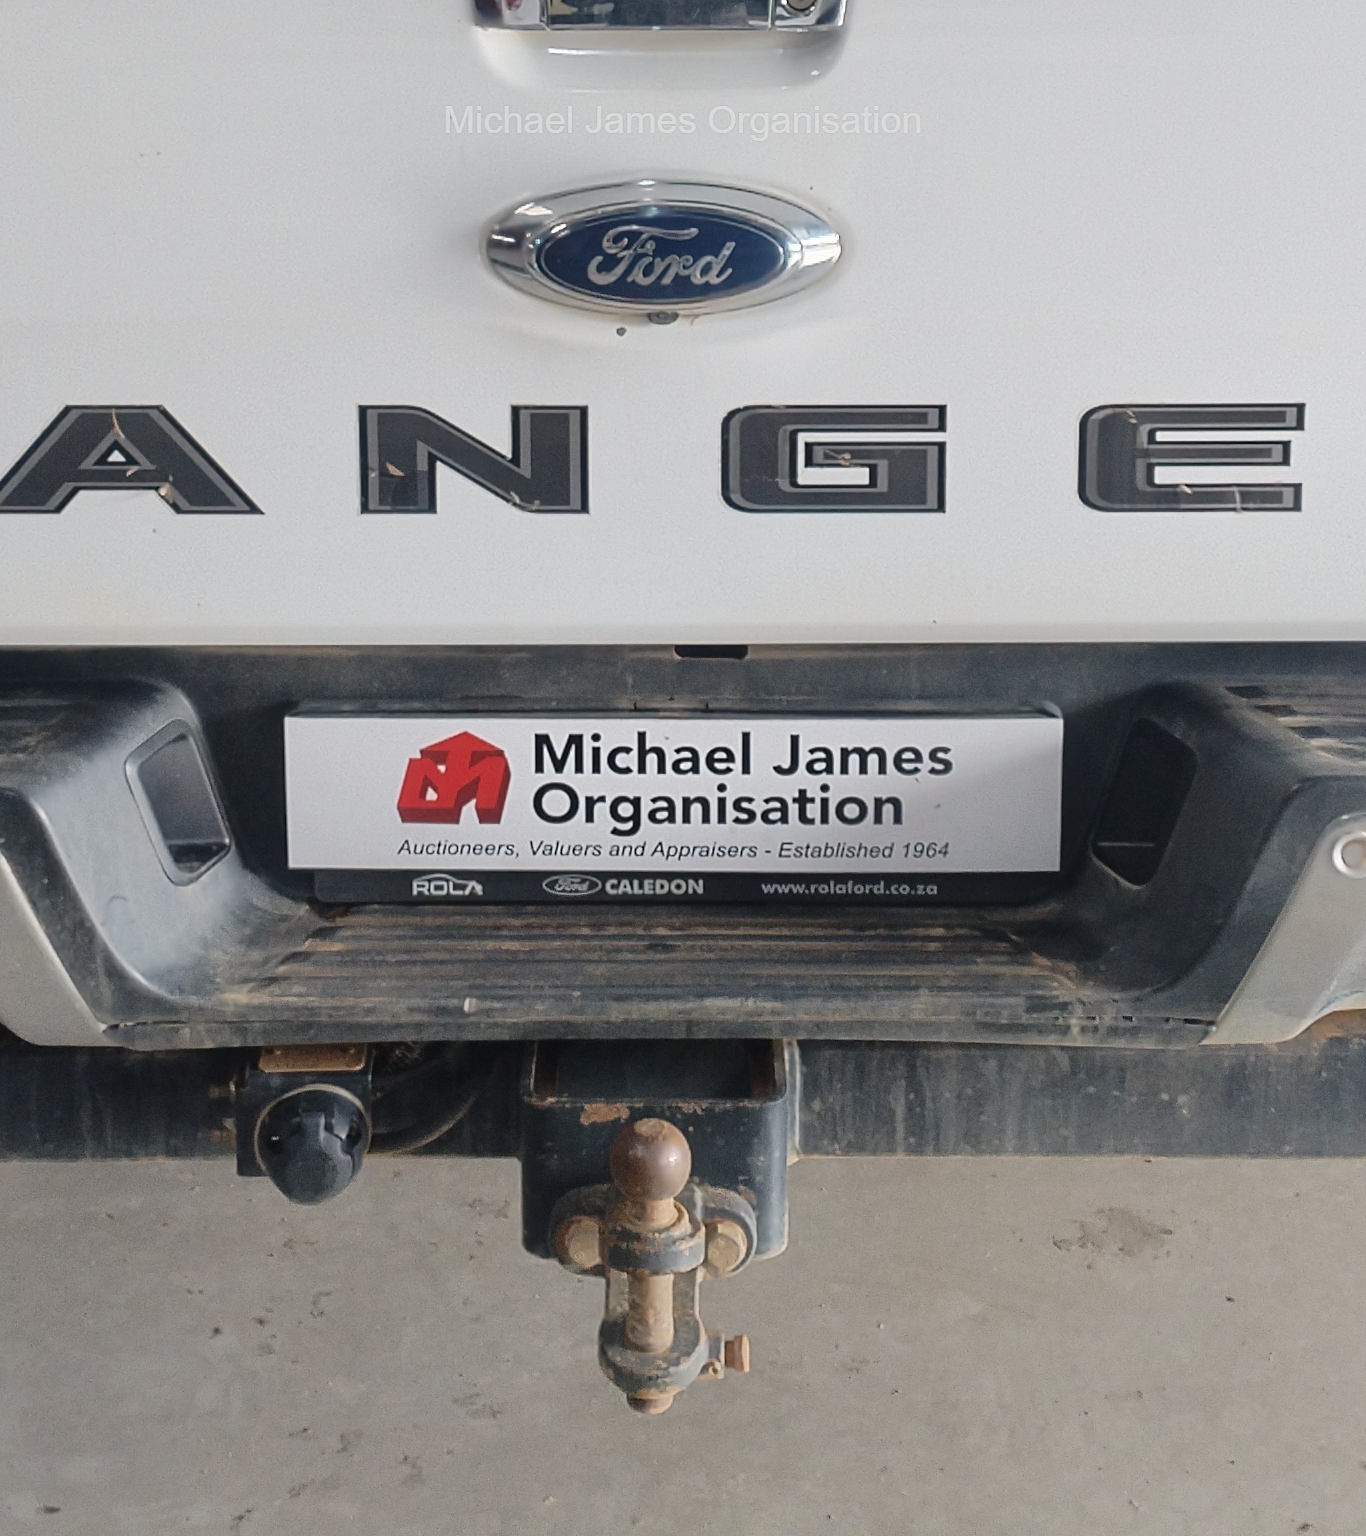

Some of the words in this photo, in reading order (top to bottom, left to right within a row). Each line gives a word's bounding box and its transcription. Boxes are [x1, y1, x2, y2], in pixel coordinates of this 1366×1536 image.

[585, 222, 738, 288] Ford
[535, 731, 750, 775] Michael
[773, 735, 952, 775] James
[533, 783, 903, 836] Organisation
[397, 839, 519, 858] Auctioneers,
[530, 841, 602, 856] Valuers
[609, 842, 646, 857] and
[651, 841, 758, 861] Appraisers
[778, 842, 894, 858] Established
[904, 842, 949, 858] 1964
[411, 877, 485, 897] ROLA
[604, 877, 705, 896] CALEDON
[760, 880, 939, 897] www.rolaford.co.za
